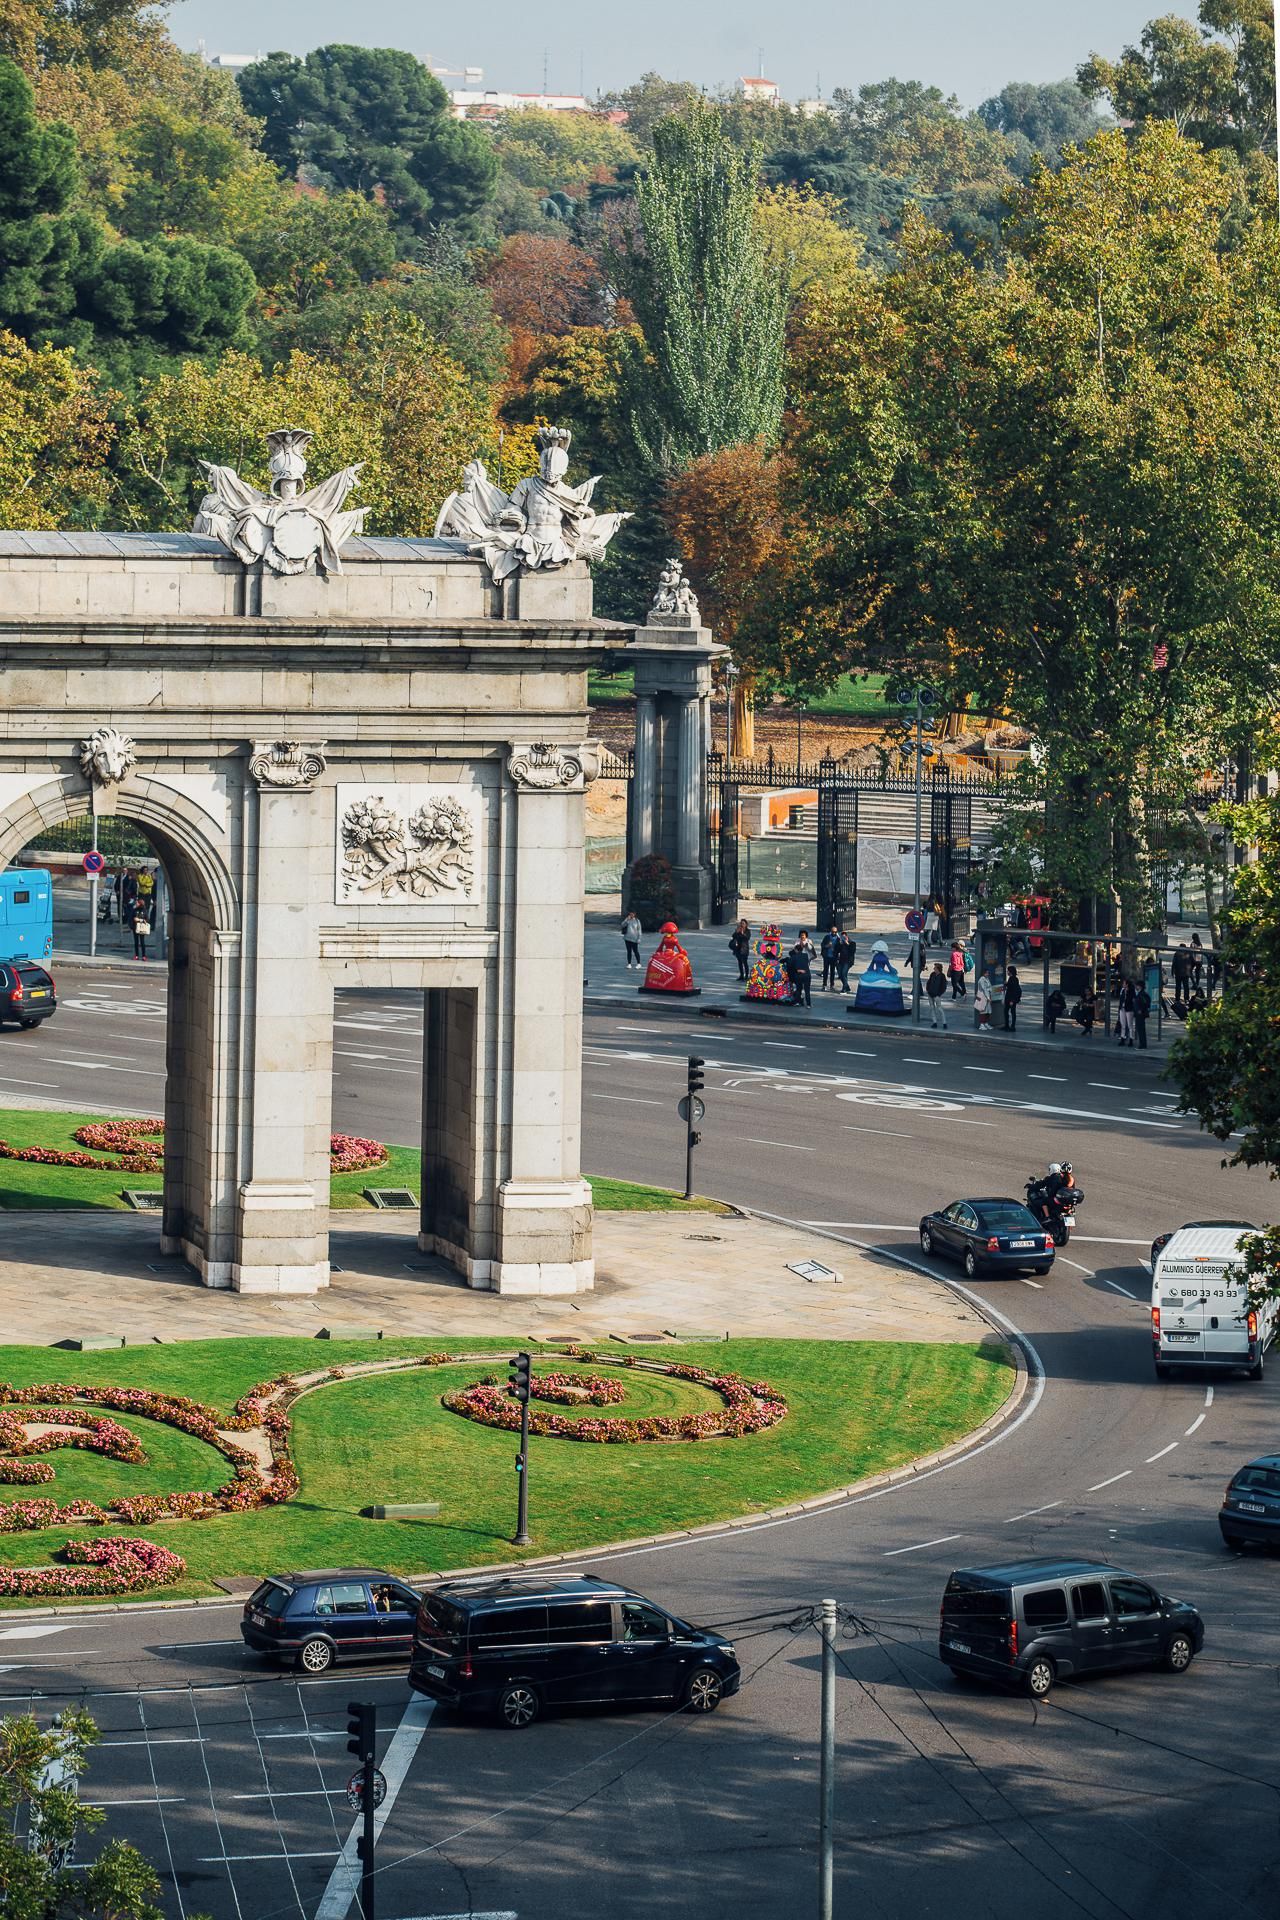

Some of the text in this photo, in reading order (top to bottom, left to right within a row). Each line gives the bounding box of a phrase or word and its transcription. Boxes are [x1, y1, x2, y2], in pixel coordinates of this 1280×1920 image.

[1162, 1265, 1194, 1274] ALUMINIOS
[1180, 1289, 1238, 1298] 680 33 43 93
